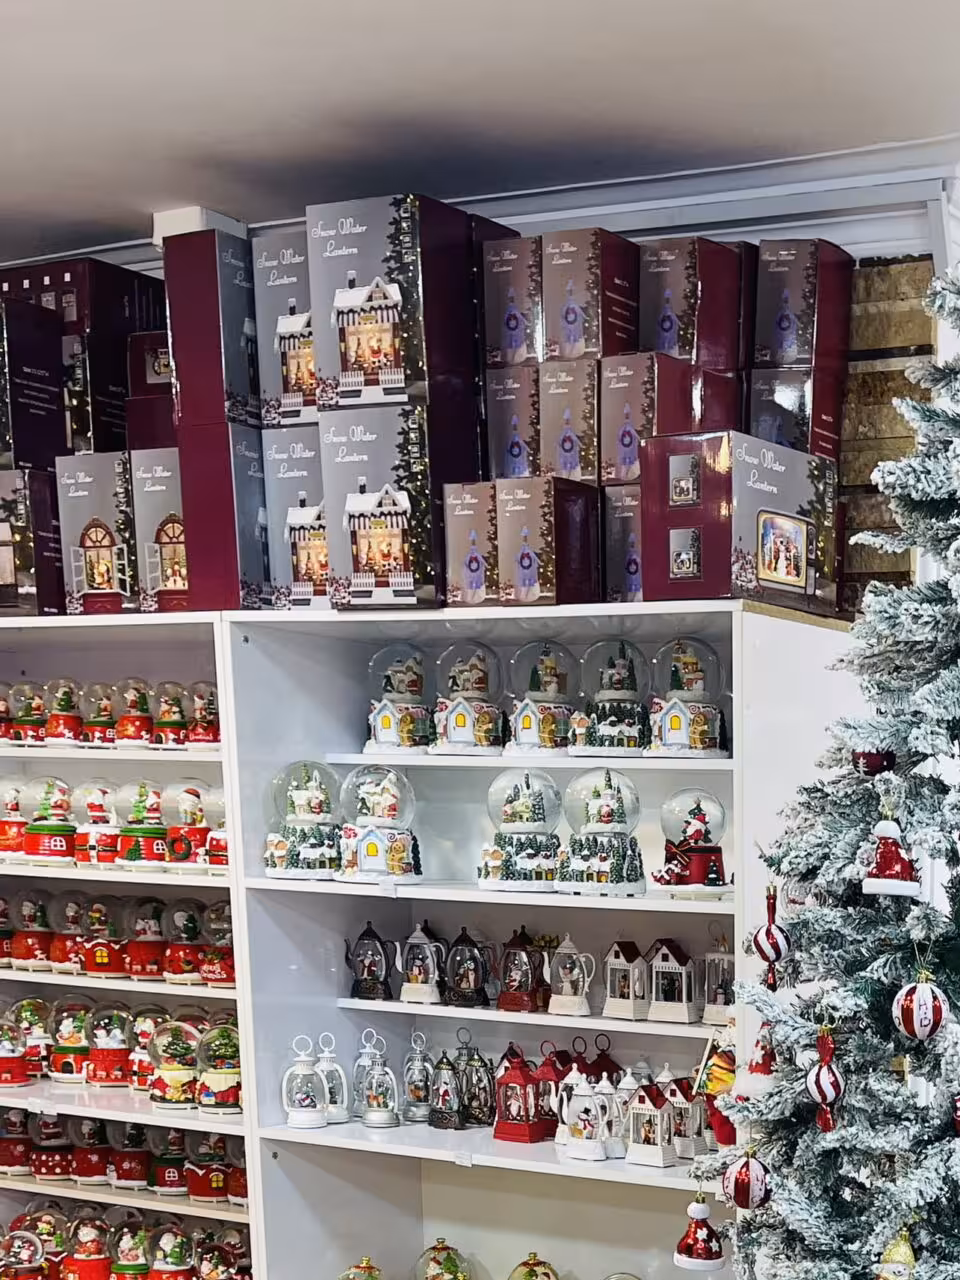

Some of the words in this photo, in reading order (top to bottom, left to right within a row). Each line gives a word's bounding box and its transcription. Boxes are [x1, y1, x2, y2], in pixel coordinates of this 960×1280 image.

[312, 221, 336, 237] Snow
[338, 218, 367, 233] Water
[323, 240, 358, 257] Lantern
[257, 252, 278, 268] Snow
[280, 248, 305, 264] Water
[267, 270, 297, 286] Lantern
[324, 427, 347, 443] Snow
[350, 425, 377, 441] Water
[267, 445, 288, 460] Snow
[290, 443, 316, 458] Water
[335, 446, 368, 463] Lantern
[736, 443, 759, 464] Snow
[760, 449, 786, 472] Water
[61, 472, 75, 484] Snow
[76, 472, 93, 482] Water
[136, 467, 152, 478] Snow
[153, 466, 172, 477] Water
[278, 463, 308, 478] Lantern
[144, 480, 166, 491] Lantern
[746, 470, 778, 494] Lantern
[68, 486, 88, 497] Lantern
